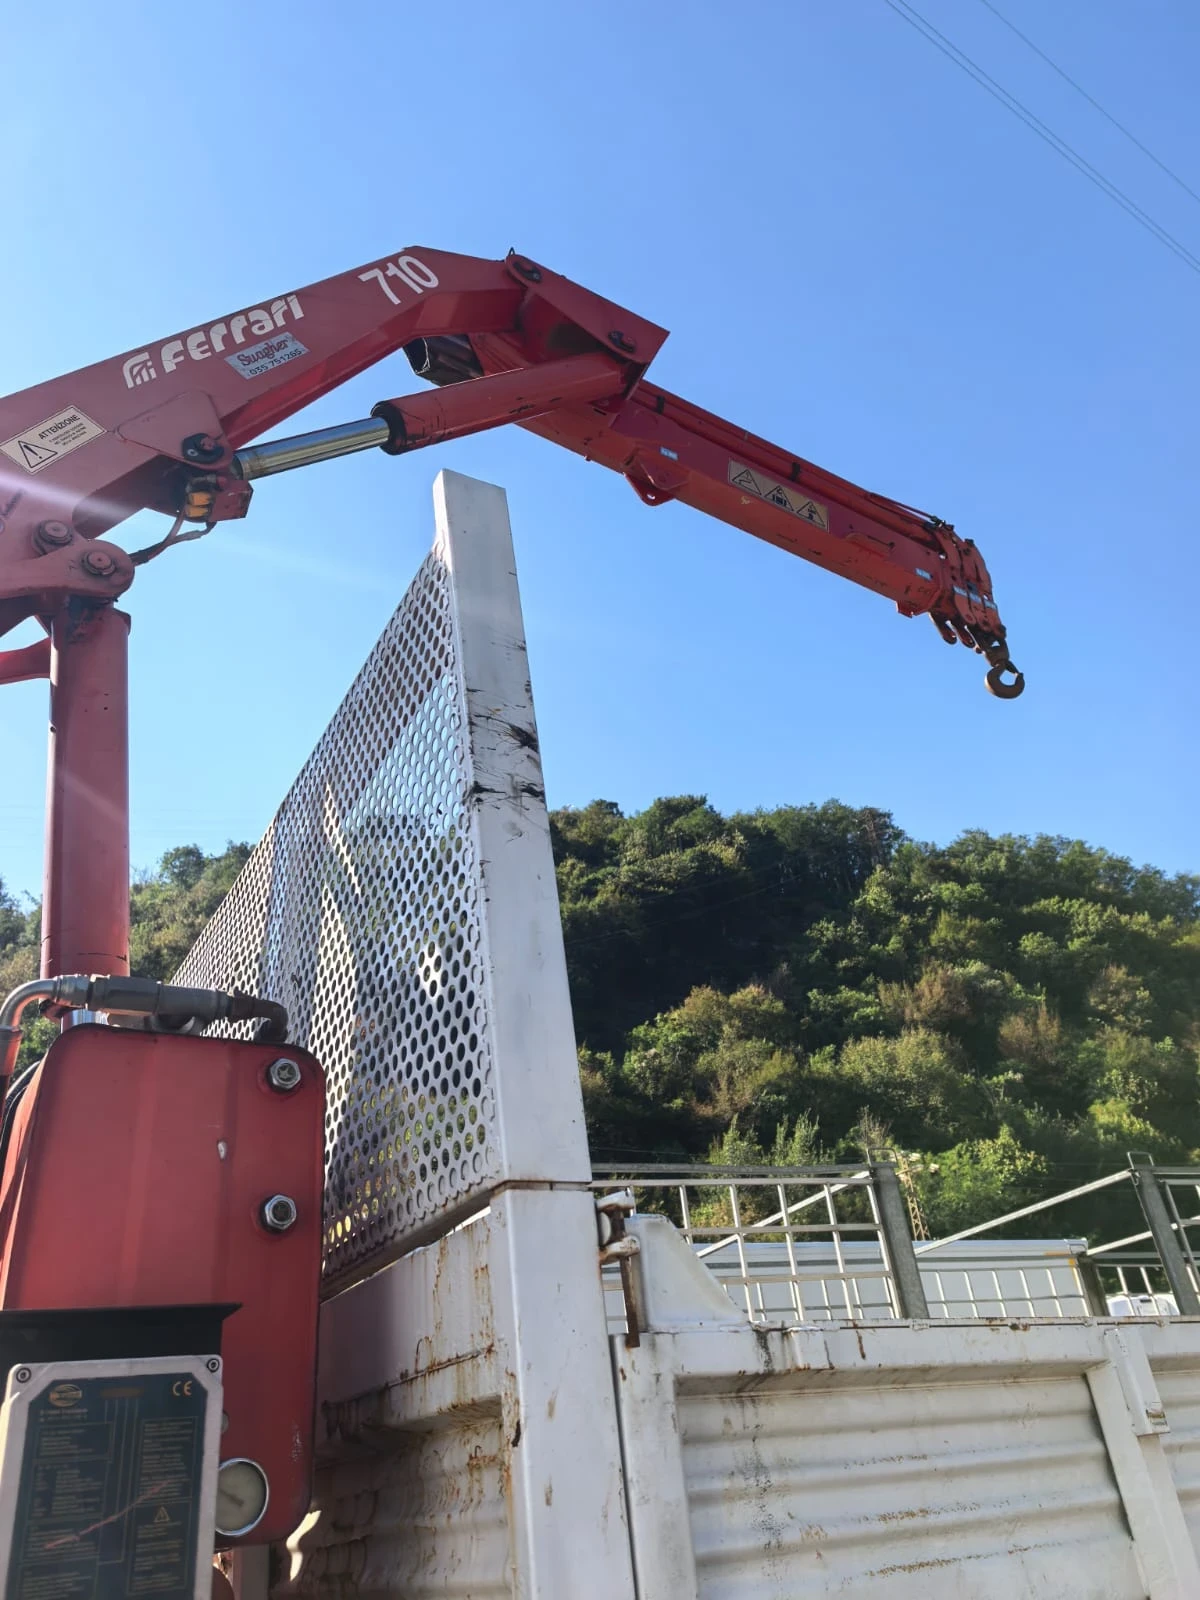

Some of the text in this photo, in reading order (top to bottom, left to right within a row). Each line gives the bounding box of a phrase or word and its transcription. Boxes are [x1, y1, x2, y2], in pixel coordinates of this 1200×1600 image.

[357, 255, 439, 305] 710
[249, 348, 303, 376] 035 751265
[38, 414, 81, 440] ATTENZIONE
[172, 1380, 193, 1397] CE
